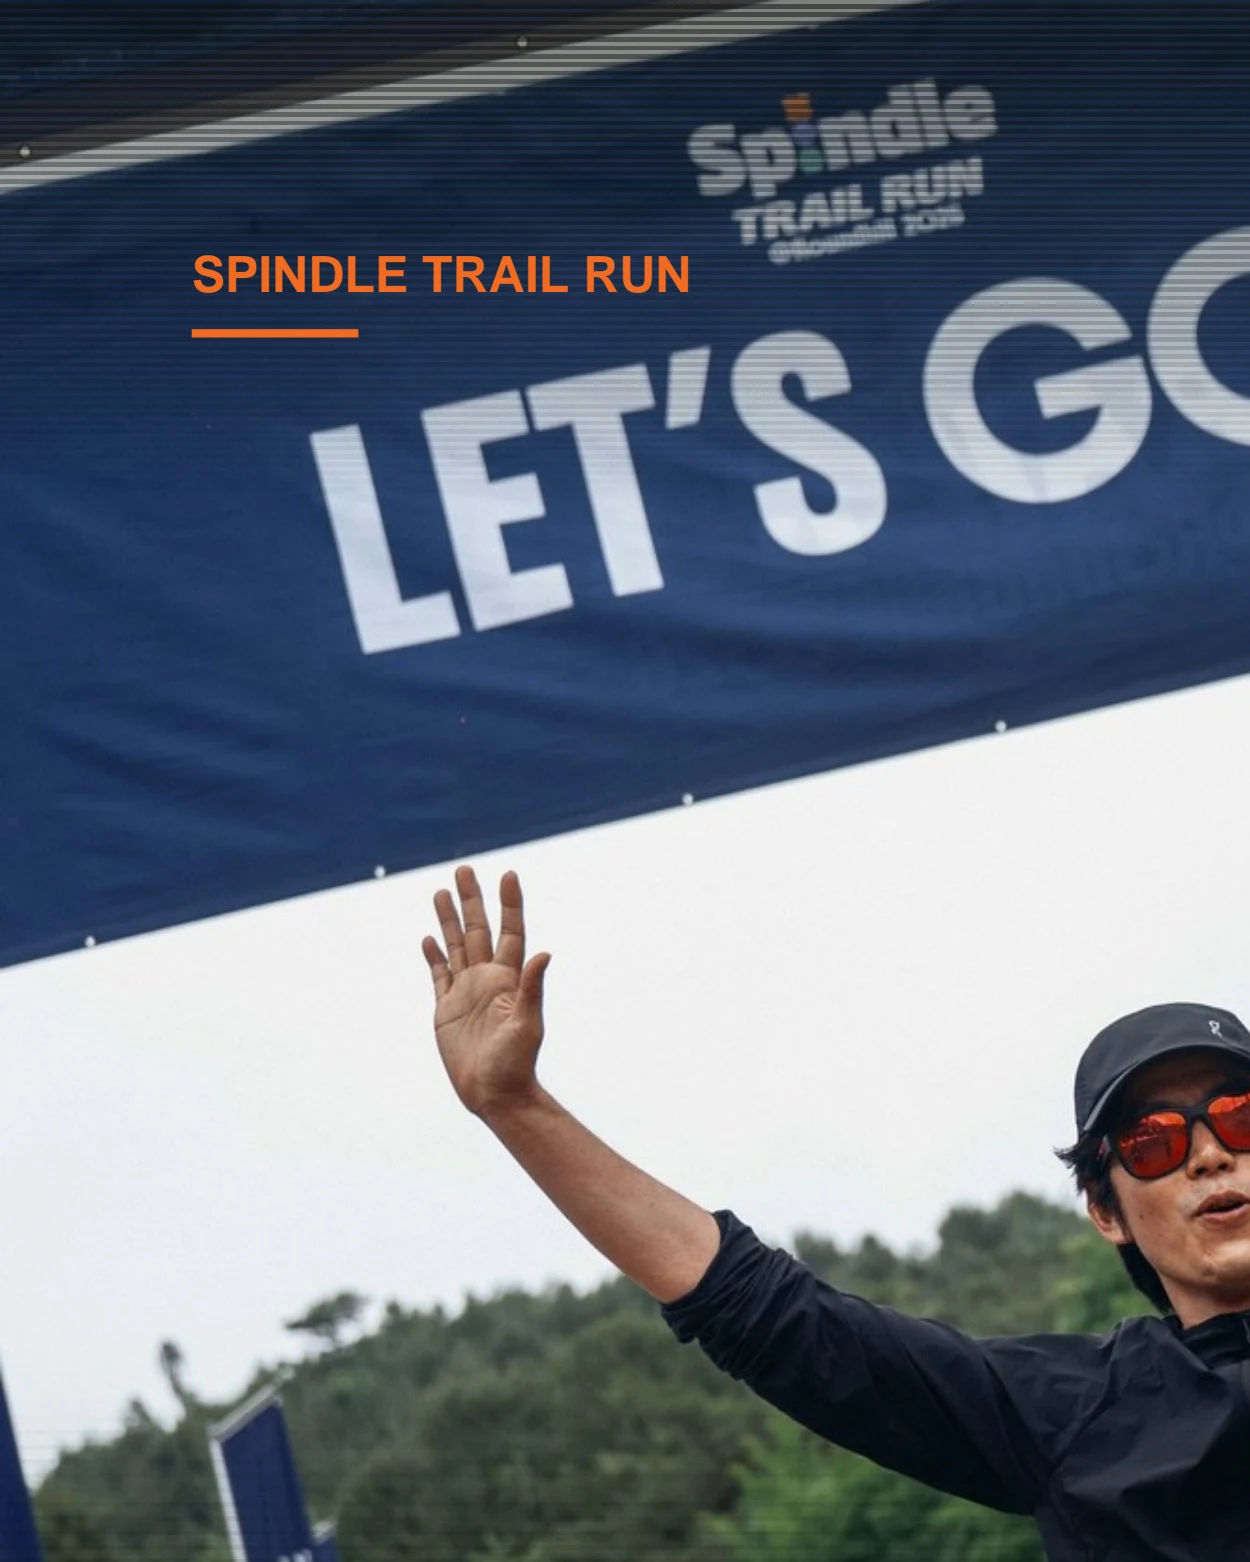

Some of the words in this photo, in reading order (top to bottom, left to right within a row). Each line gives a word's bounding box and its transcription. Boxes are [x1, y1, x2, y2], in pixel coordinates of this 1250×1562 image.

[687, 78, 998, 197] Spindle
[731, 184, 874, 246] TRAIL
[880, 157, 984, 213] RUN
[309, 330, 888, 656] LET'S
